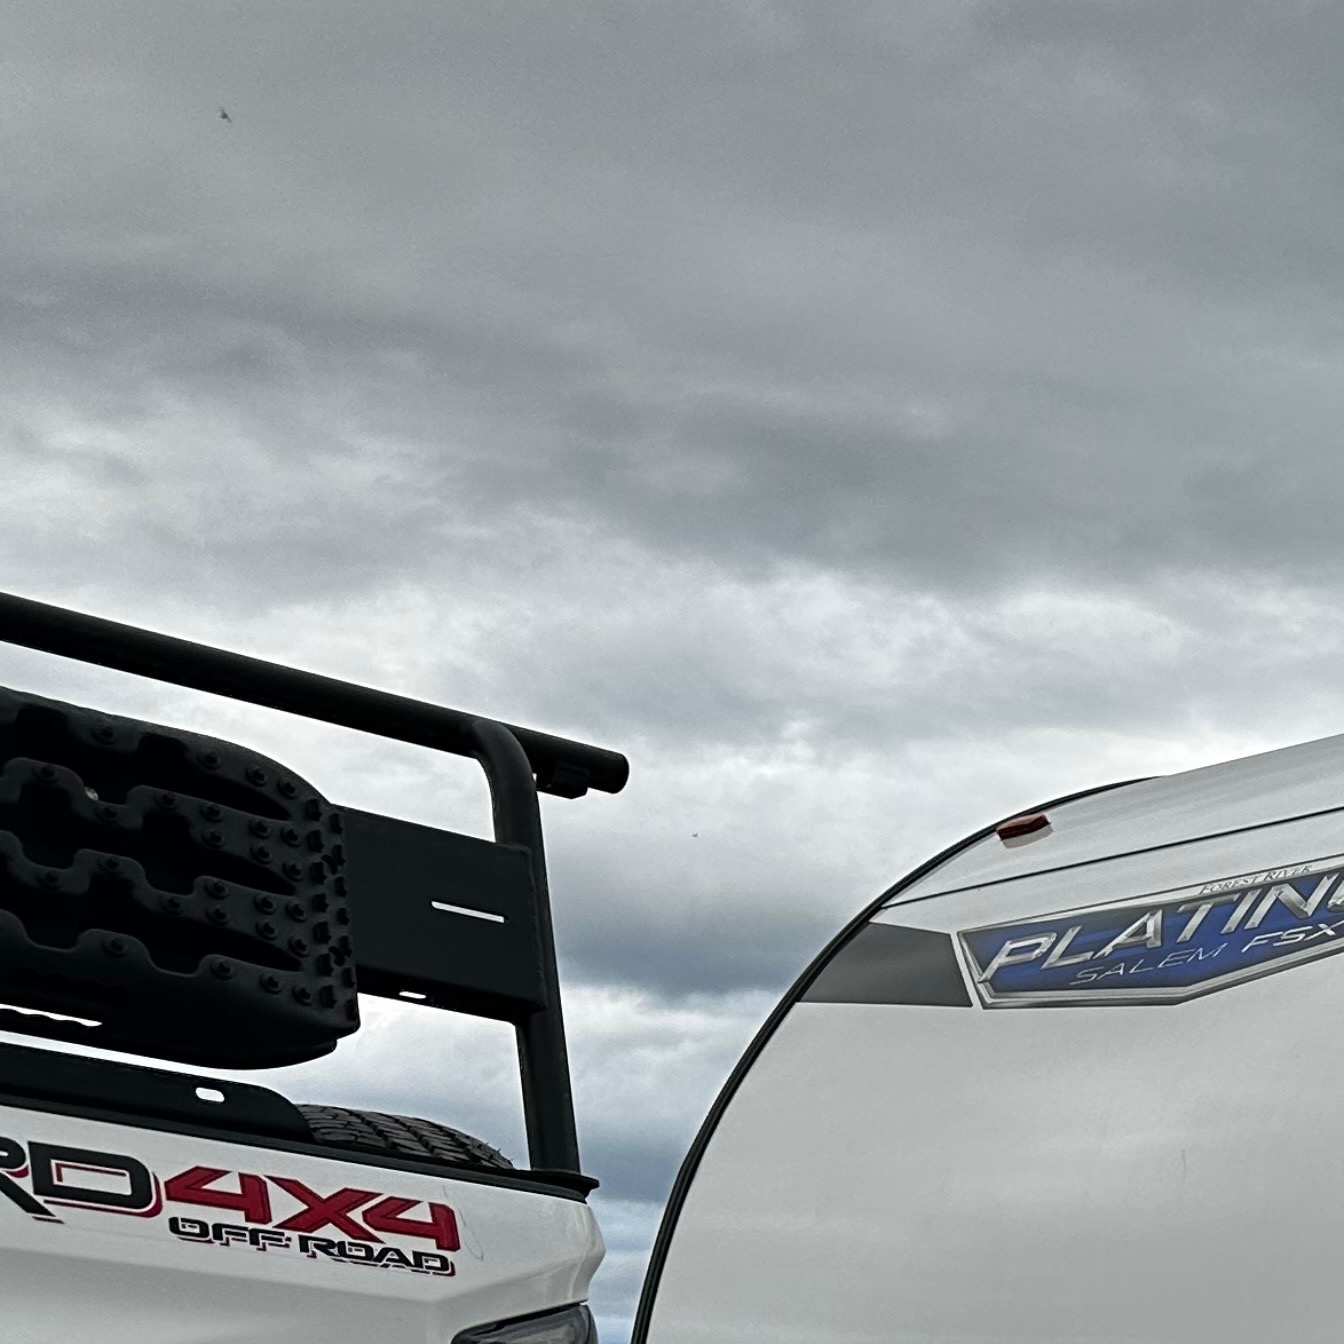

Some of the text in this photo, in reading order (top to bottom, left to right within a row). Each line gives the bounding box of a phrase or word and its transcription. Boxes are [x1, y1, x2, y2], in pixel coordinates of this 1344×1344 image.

[1069, 942, 1228, 985] SALEM
[164, 1165, 461, 1252] 4X4
[168, 1216, 456, 1278] OFF ROAD
